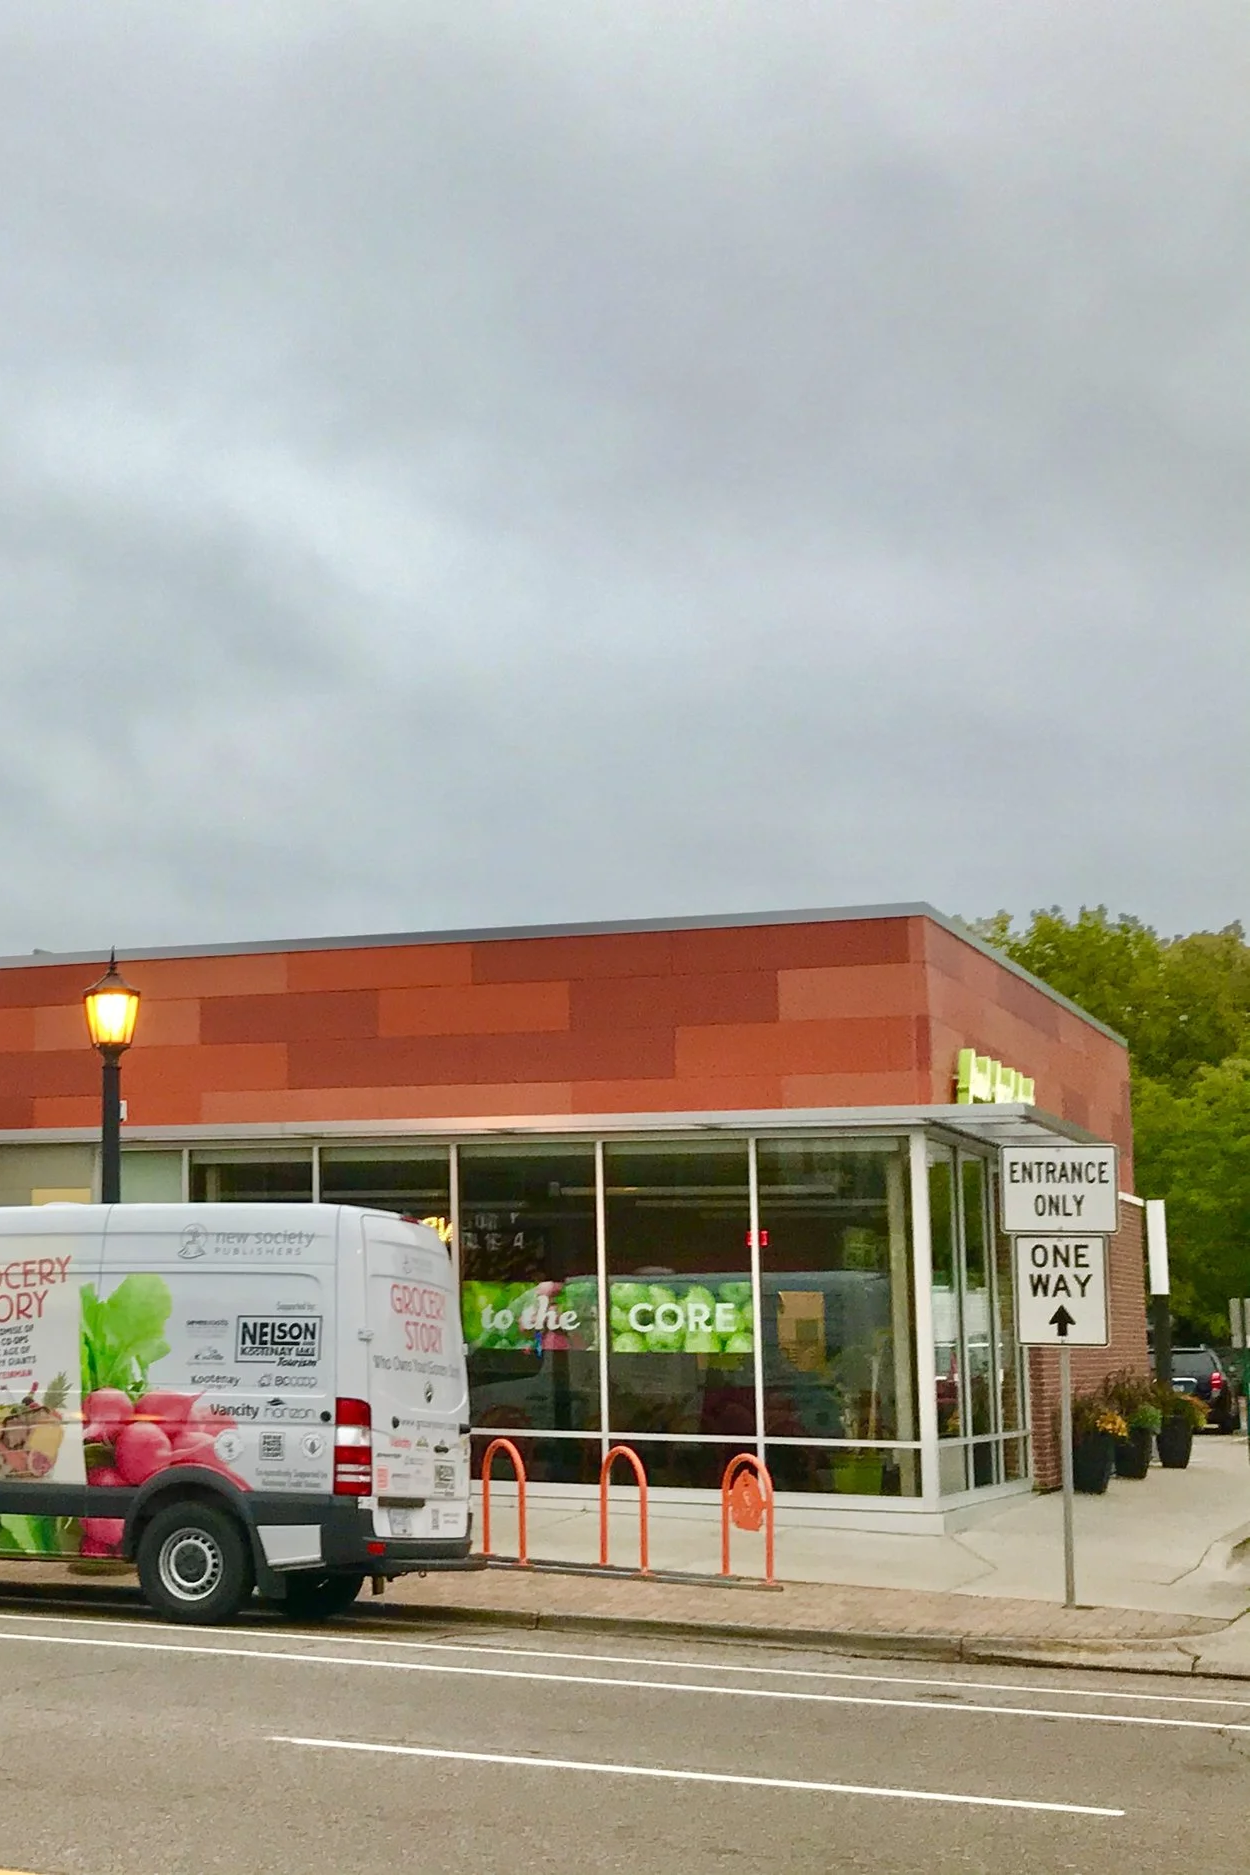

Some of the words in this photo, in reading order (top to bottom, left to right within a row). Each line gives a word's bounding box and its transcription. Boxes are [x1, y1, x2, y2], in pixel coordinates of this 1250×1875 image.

[1008, 1160, 1110, 1184] ENTRANCE
[1034, 1193, 1085, 1217] ONLY
[214, 1232, 250, 1244] new
[254, 1230, 316, 1248] society
[214, 1246, 302, 1256] PUBLISHERS
[1031, 1243, 1090, 1269] ONE
[1029, 1273, 1093, 1298] WAY
[481, 1303, 514, 1331] to
[520, 1294, 582, 1332] the
[629, 1302, 736, 1333] CORE
[241, 1322, 317, 1346] NELSON
[240, 1346, 293, 1357] KOOTENAY
[276, 1357, 318, 1368] Tourism
[190, 1374, 242, 1387] Kootenay
[210, 1403, 260, 1419] Vancity
[264, 1407, 315, 1419] horizon
